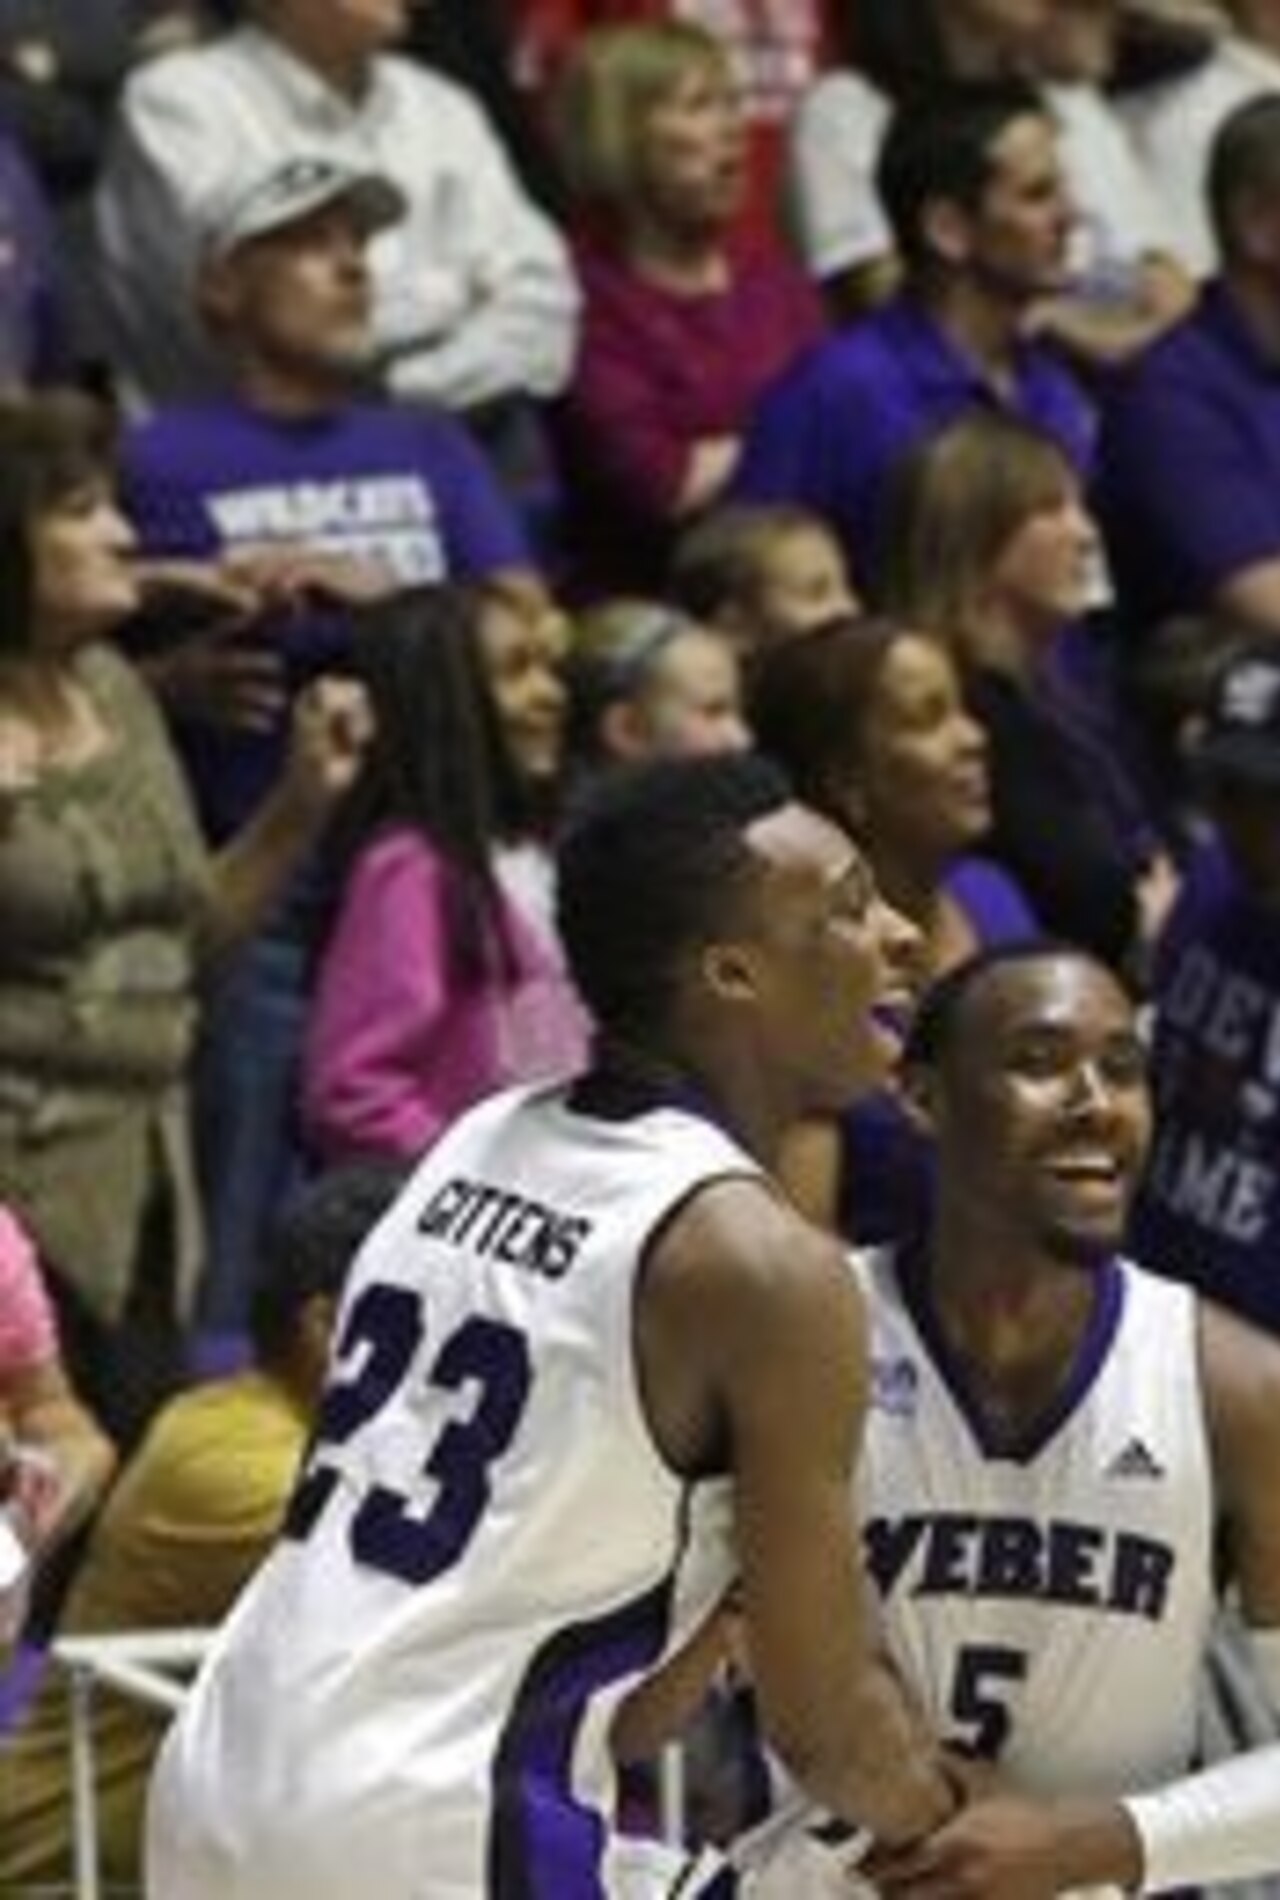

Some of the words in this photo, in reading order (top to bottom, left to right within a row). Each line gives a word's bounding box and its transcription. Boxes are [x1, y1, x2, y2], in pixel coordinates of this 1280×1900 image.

[415, 1179, 592, 1280] GITTENS
[284, 1282, 533, 1588] 23
[938, 1642, 1029, 1761] 5
